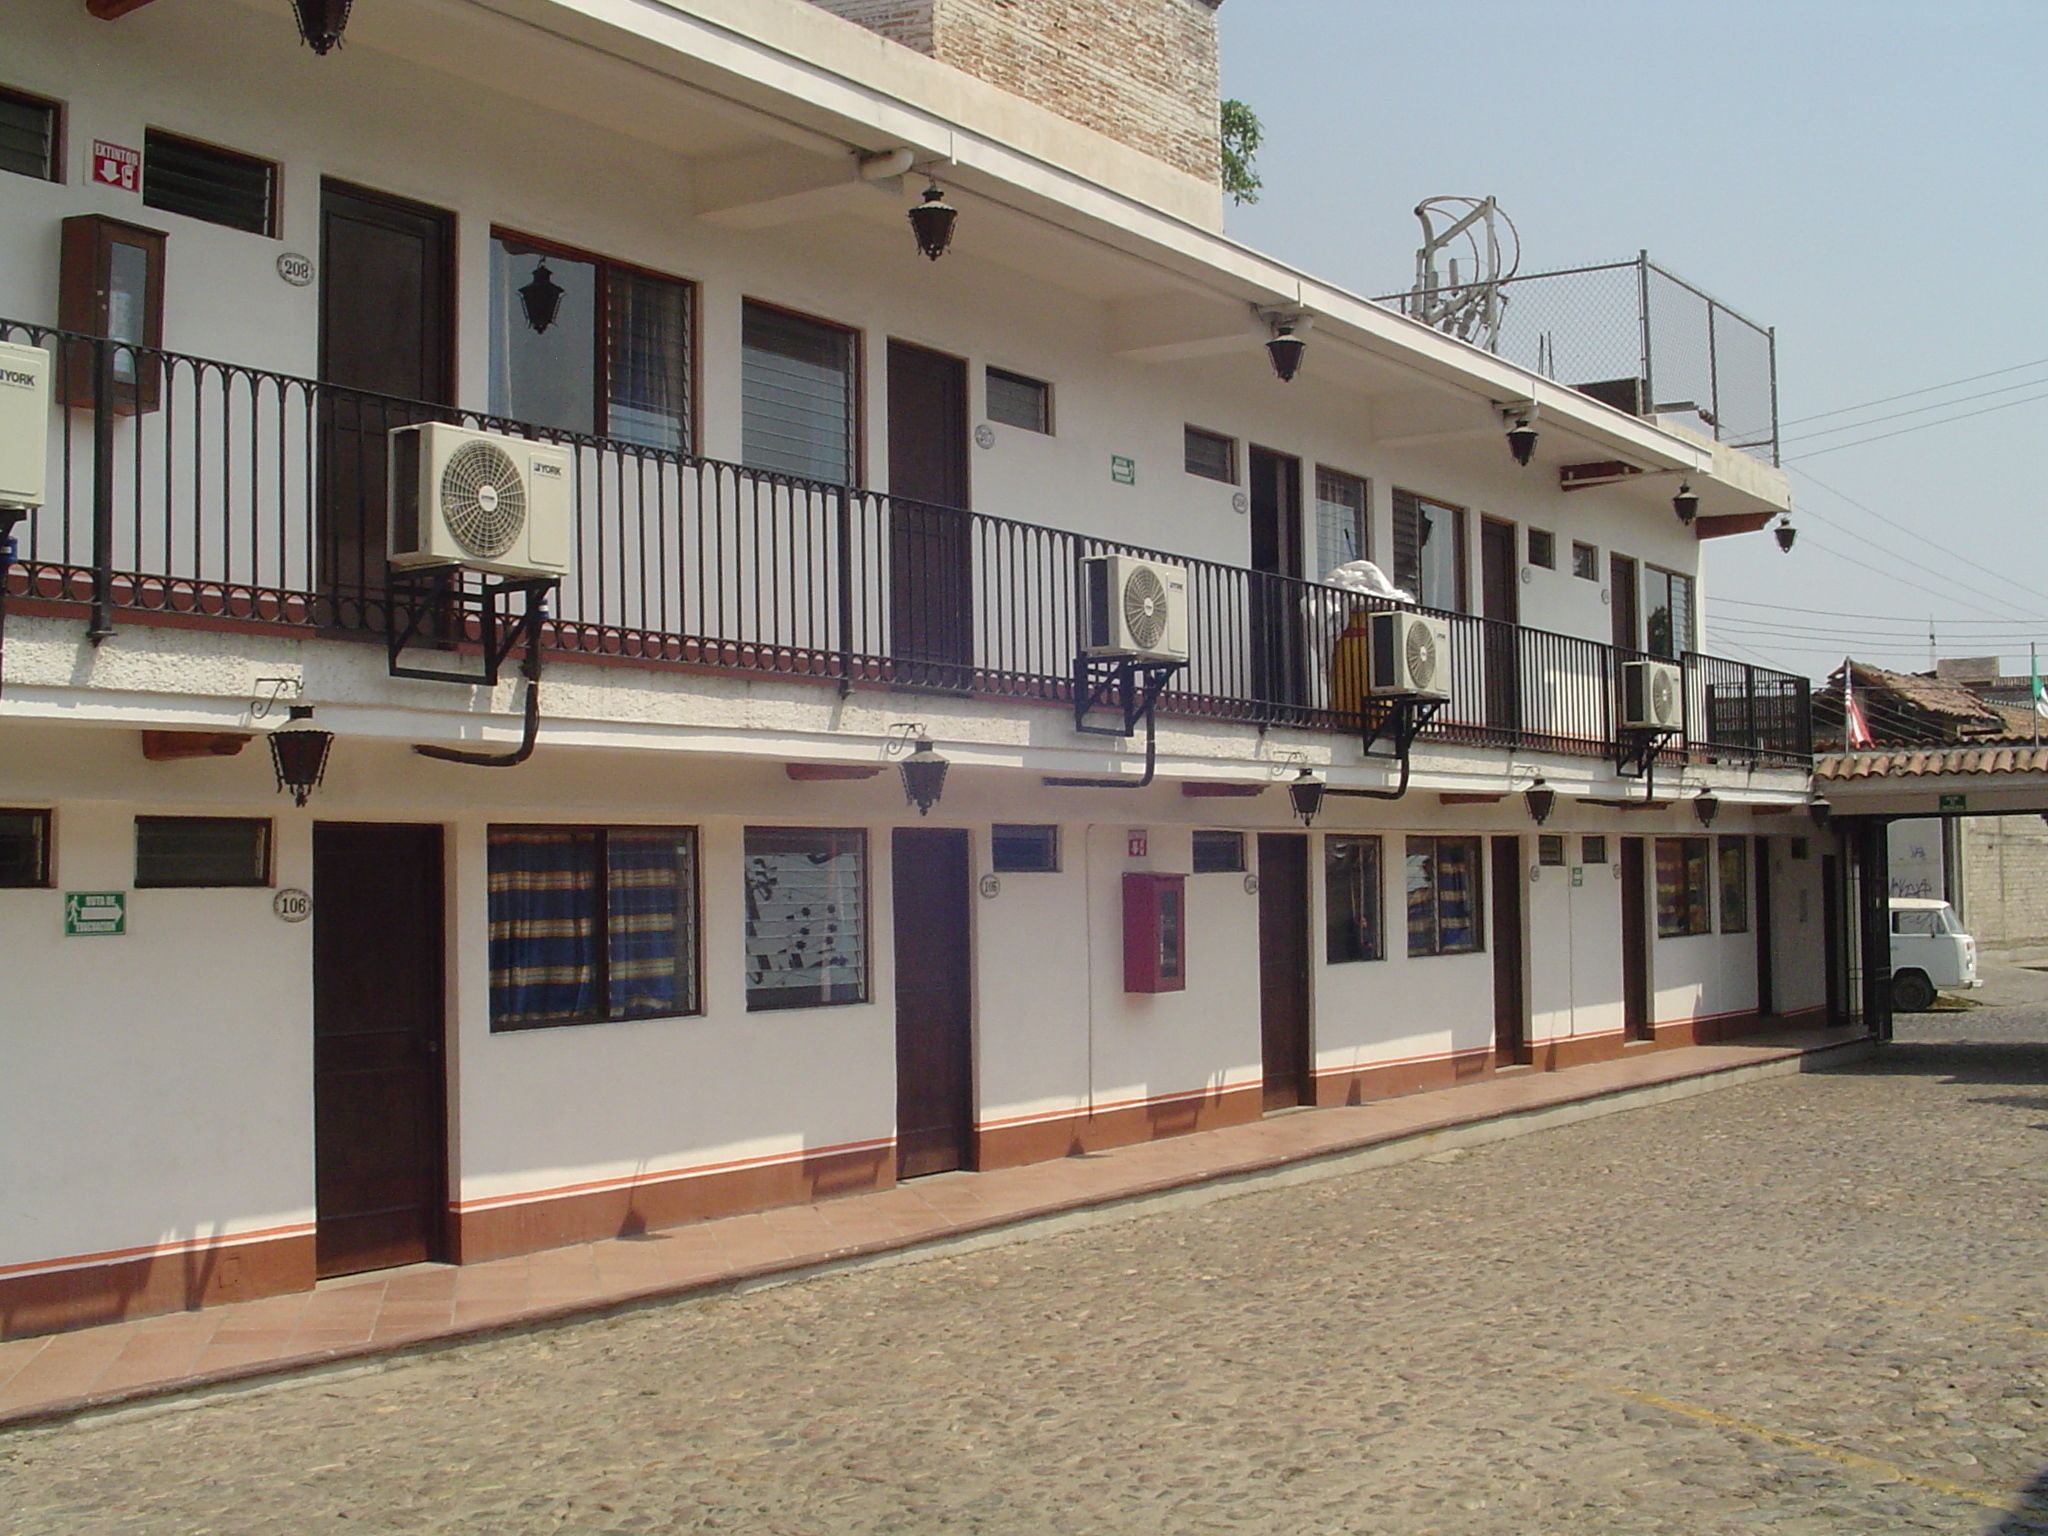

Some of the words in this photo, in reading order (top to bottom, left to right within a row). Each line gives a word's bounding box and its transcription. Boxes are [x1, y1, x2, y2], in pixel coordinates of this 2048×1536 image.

[95, 143, 138, 167] EXTINTOR
[284, 259, 309, 279] 208
[4, 369, 36, 387] YORK
[282, 897, 306, 914] 106
